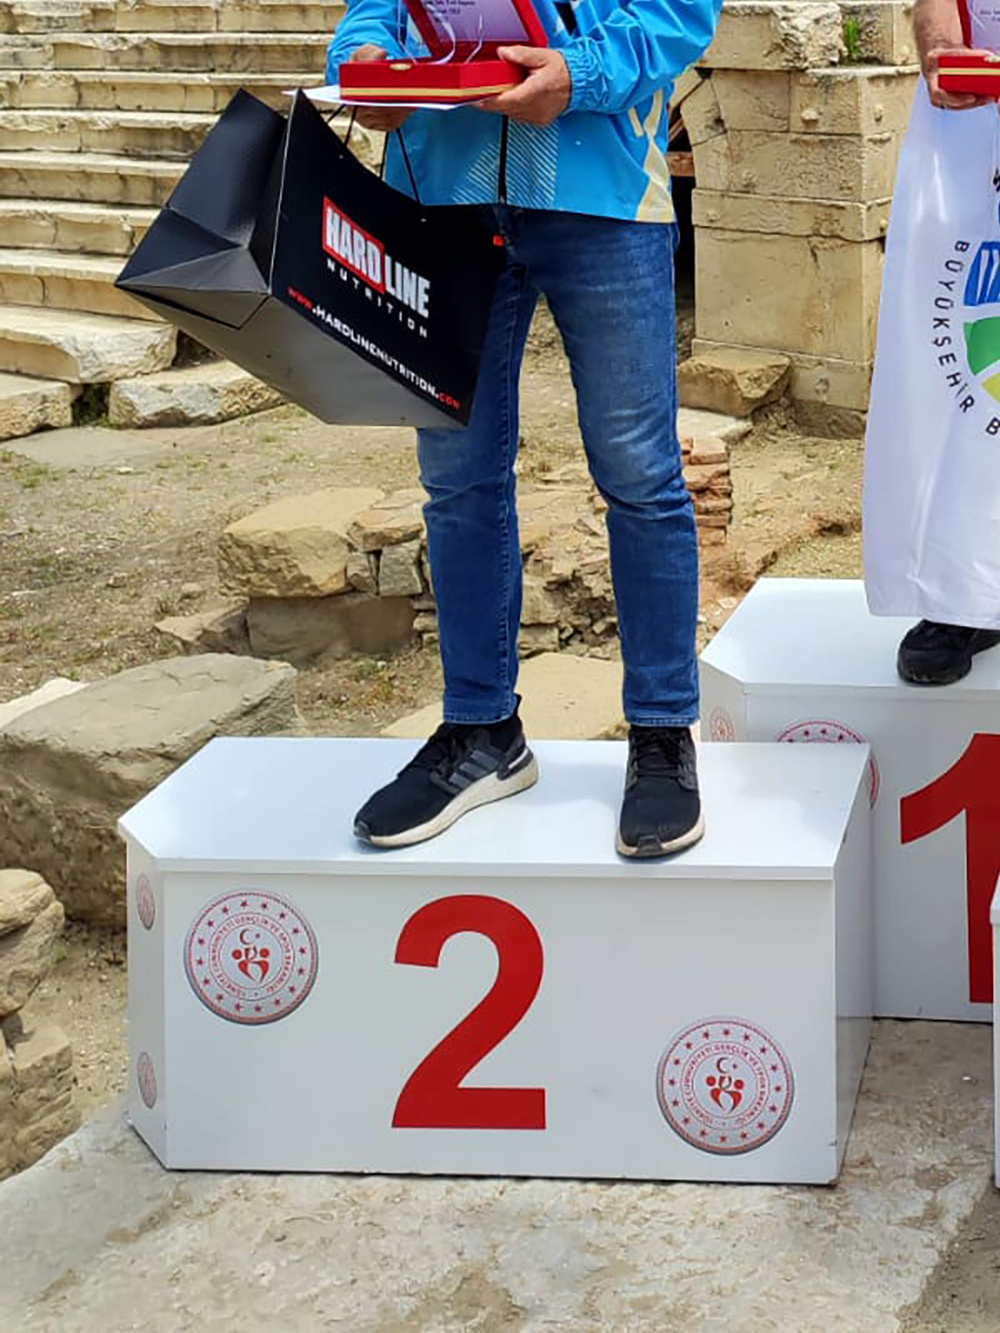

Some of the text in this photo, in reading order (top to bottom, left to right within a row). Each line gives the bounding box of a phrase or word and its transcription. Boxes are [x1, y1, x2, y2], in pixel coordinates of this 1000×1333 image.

[325, 207, 431, 318] HARD LINE
[327, 258, 428, 339] NUTRITION
[932, 239, 975, 413] BÜYÜKŞEHİR
[393, 895, 547, 1130] 2
